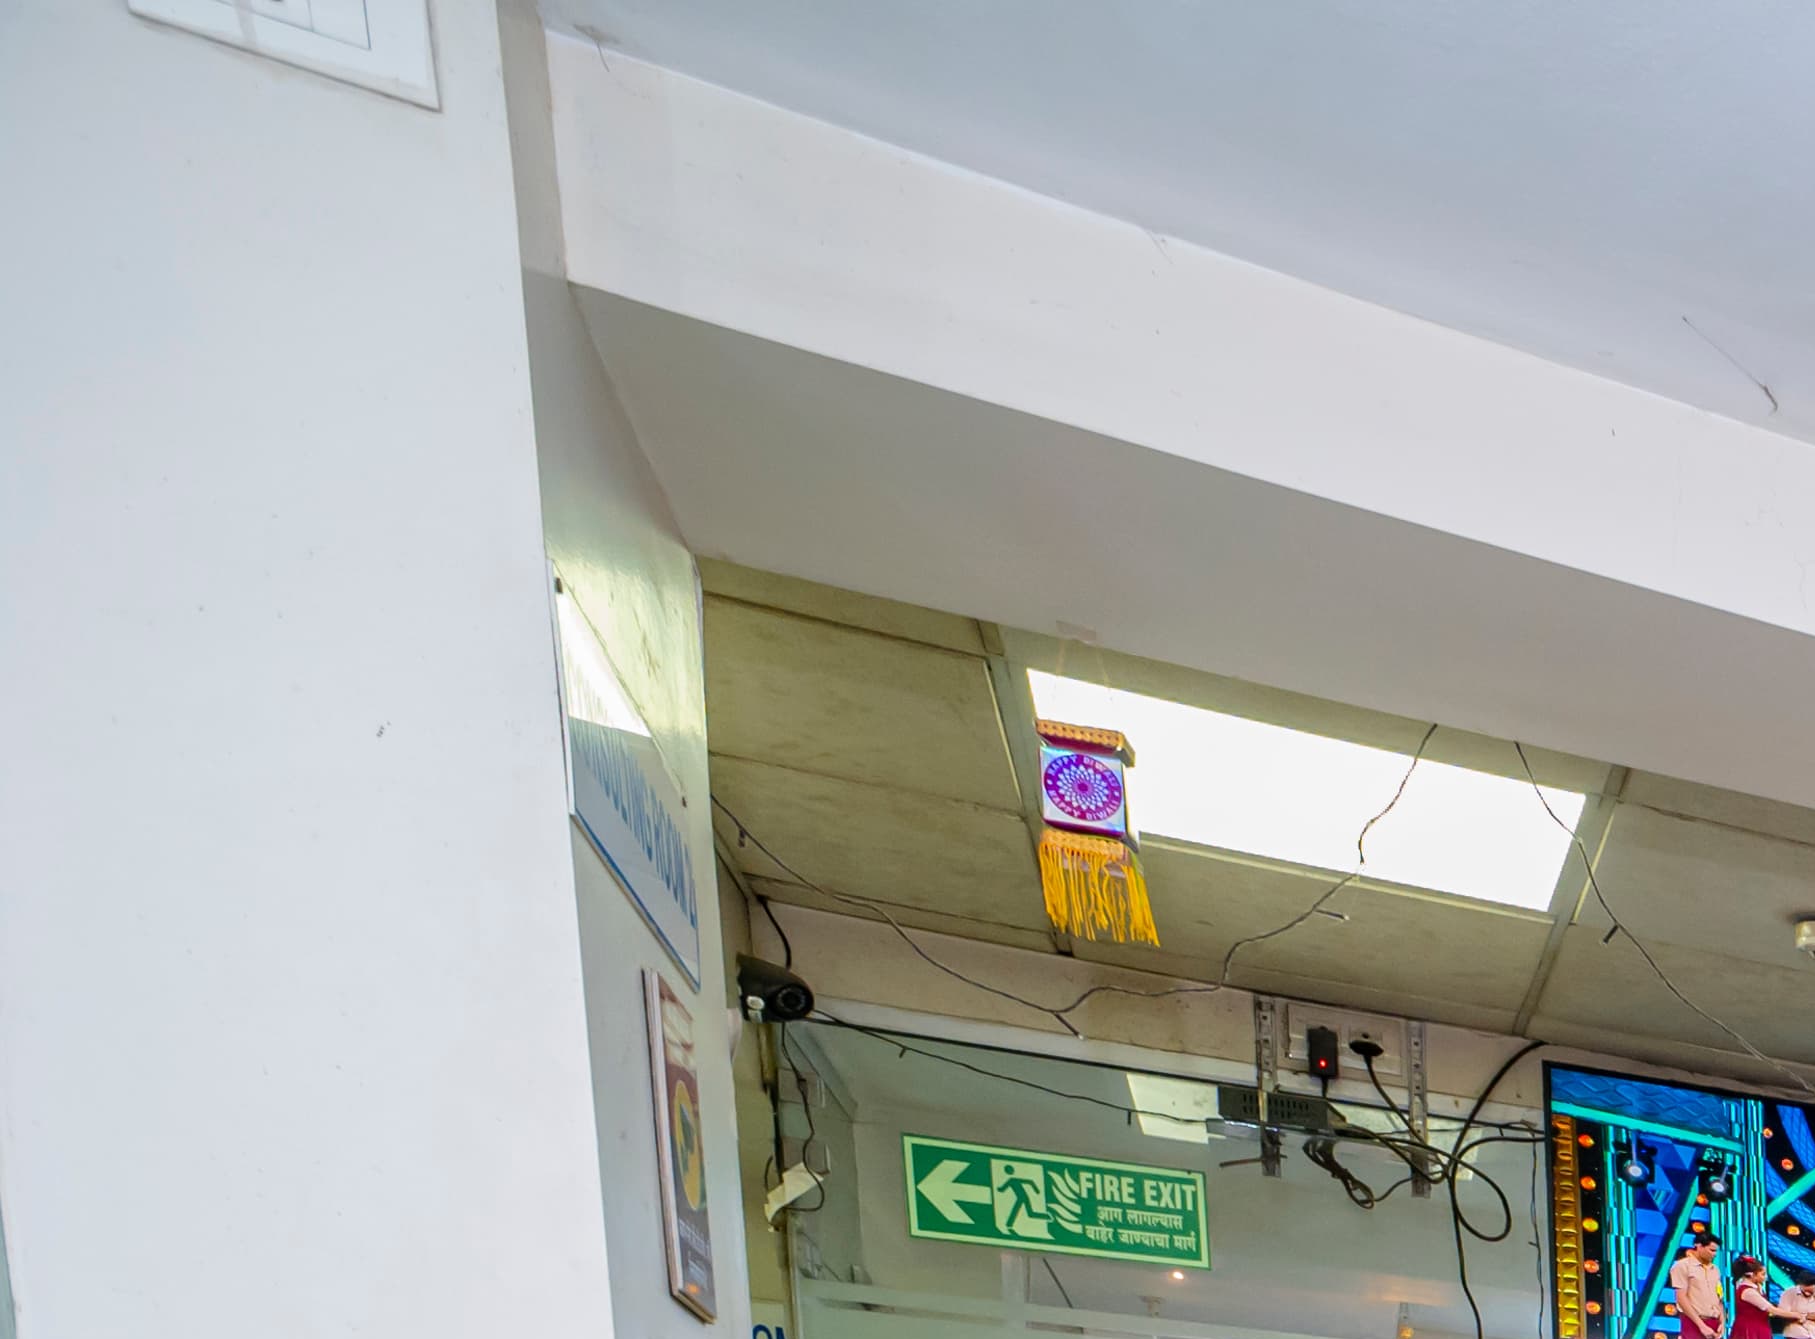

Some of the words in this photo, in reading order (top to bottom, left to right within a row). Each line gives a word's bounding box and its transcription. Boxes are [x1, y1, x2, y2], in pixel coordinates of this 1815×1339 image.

[1080, 1171, 1136, 1204] FIRE
[1143, 1179, 1196, 1211] EXIT
[1097, 1206, 1122, 1223] आग
[1085, 1221, 1114, 1243] बाहेर
[1172, 1231, 1196, 1252] मार्ग
